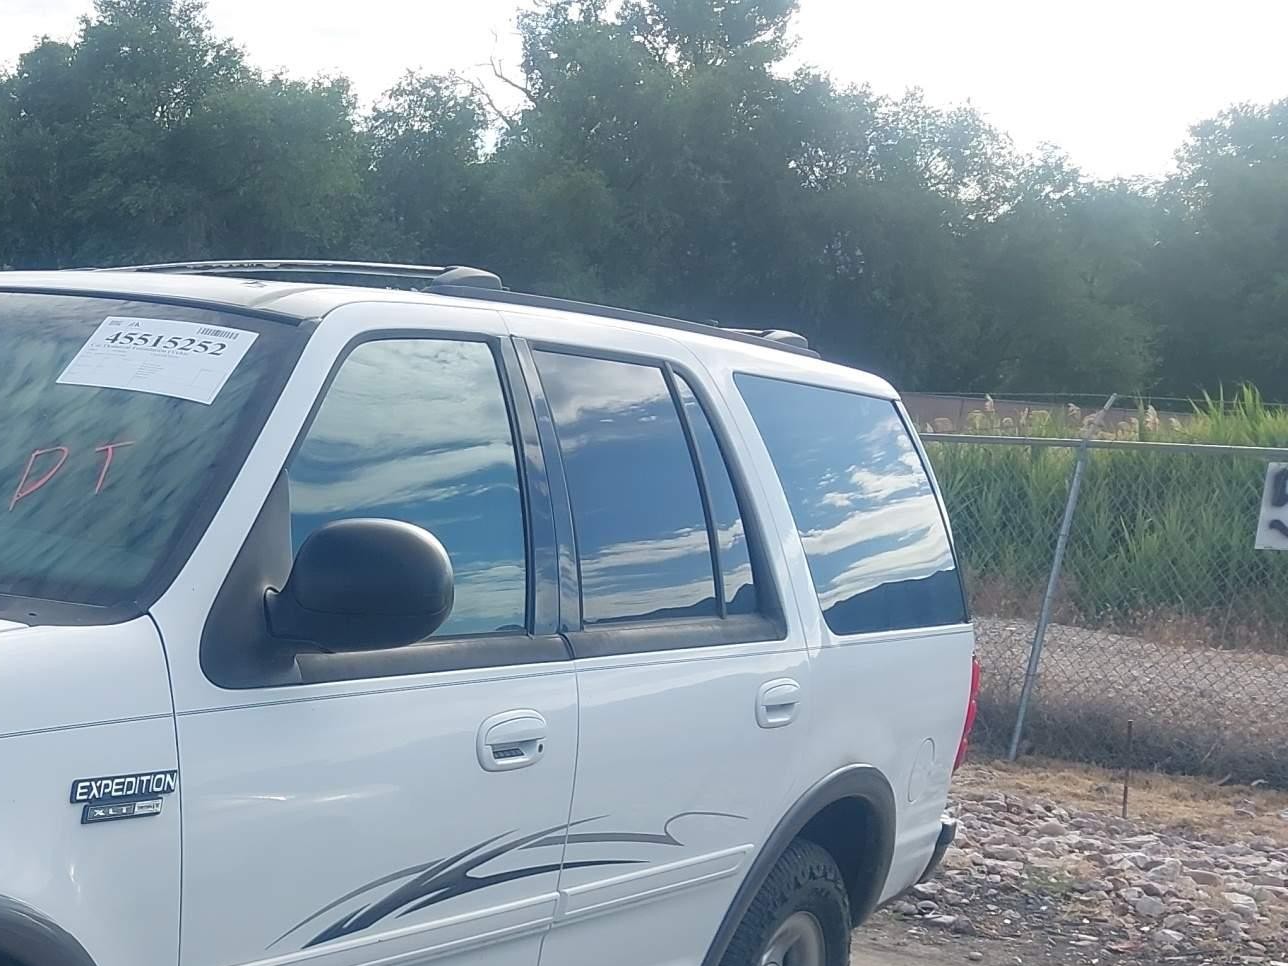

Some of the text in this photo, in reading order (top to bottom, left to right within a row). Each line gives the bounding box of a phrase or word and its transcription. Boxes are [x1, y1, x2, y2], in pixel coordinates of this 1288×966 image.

[104, 331, 227, 356] 45515252
[75, 772, 177, 801] EXPEDITION
[93, 806, 130, 818] XLT
